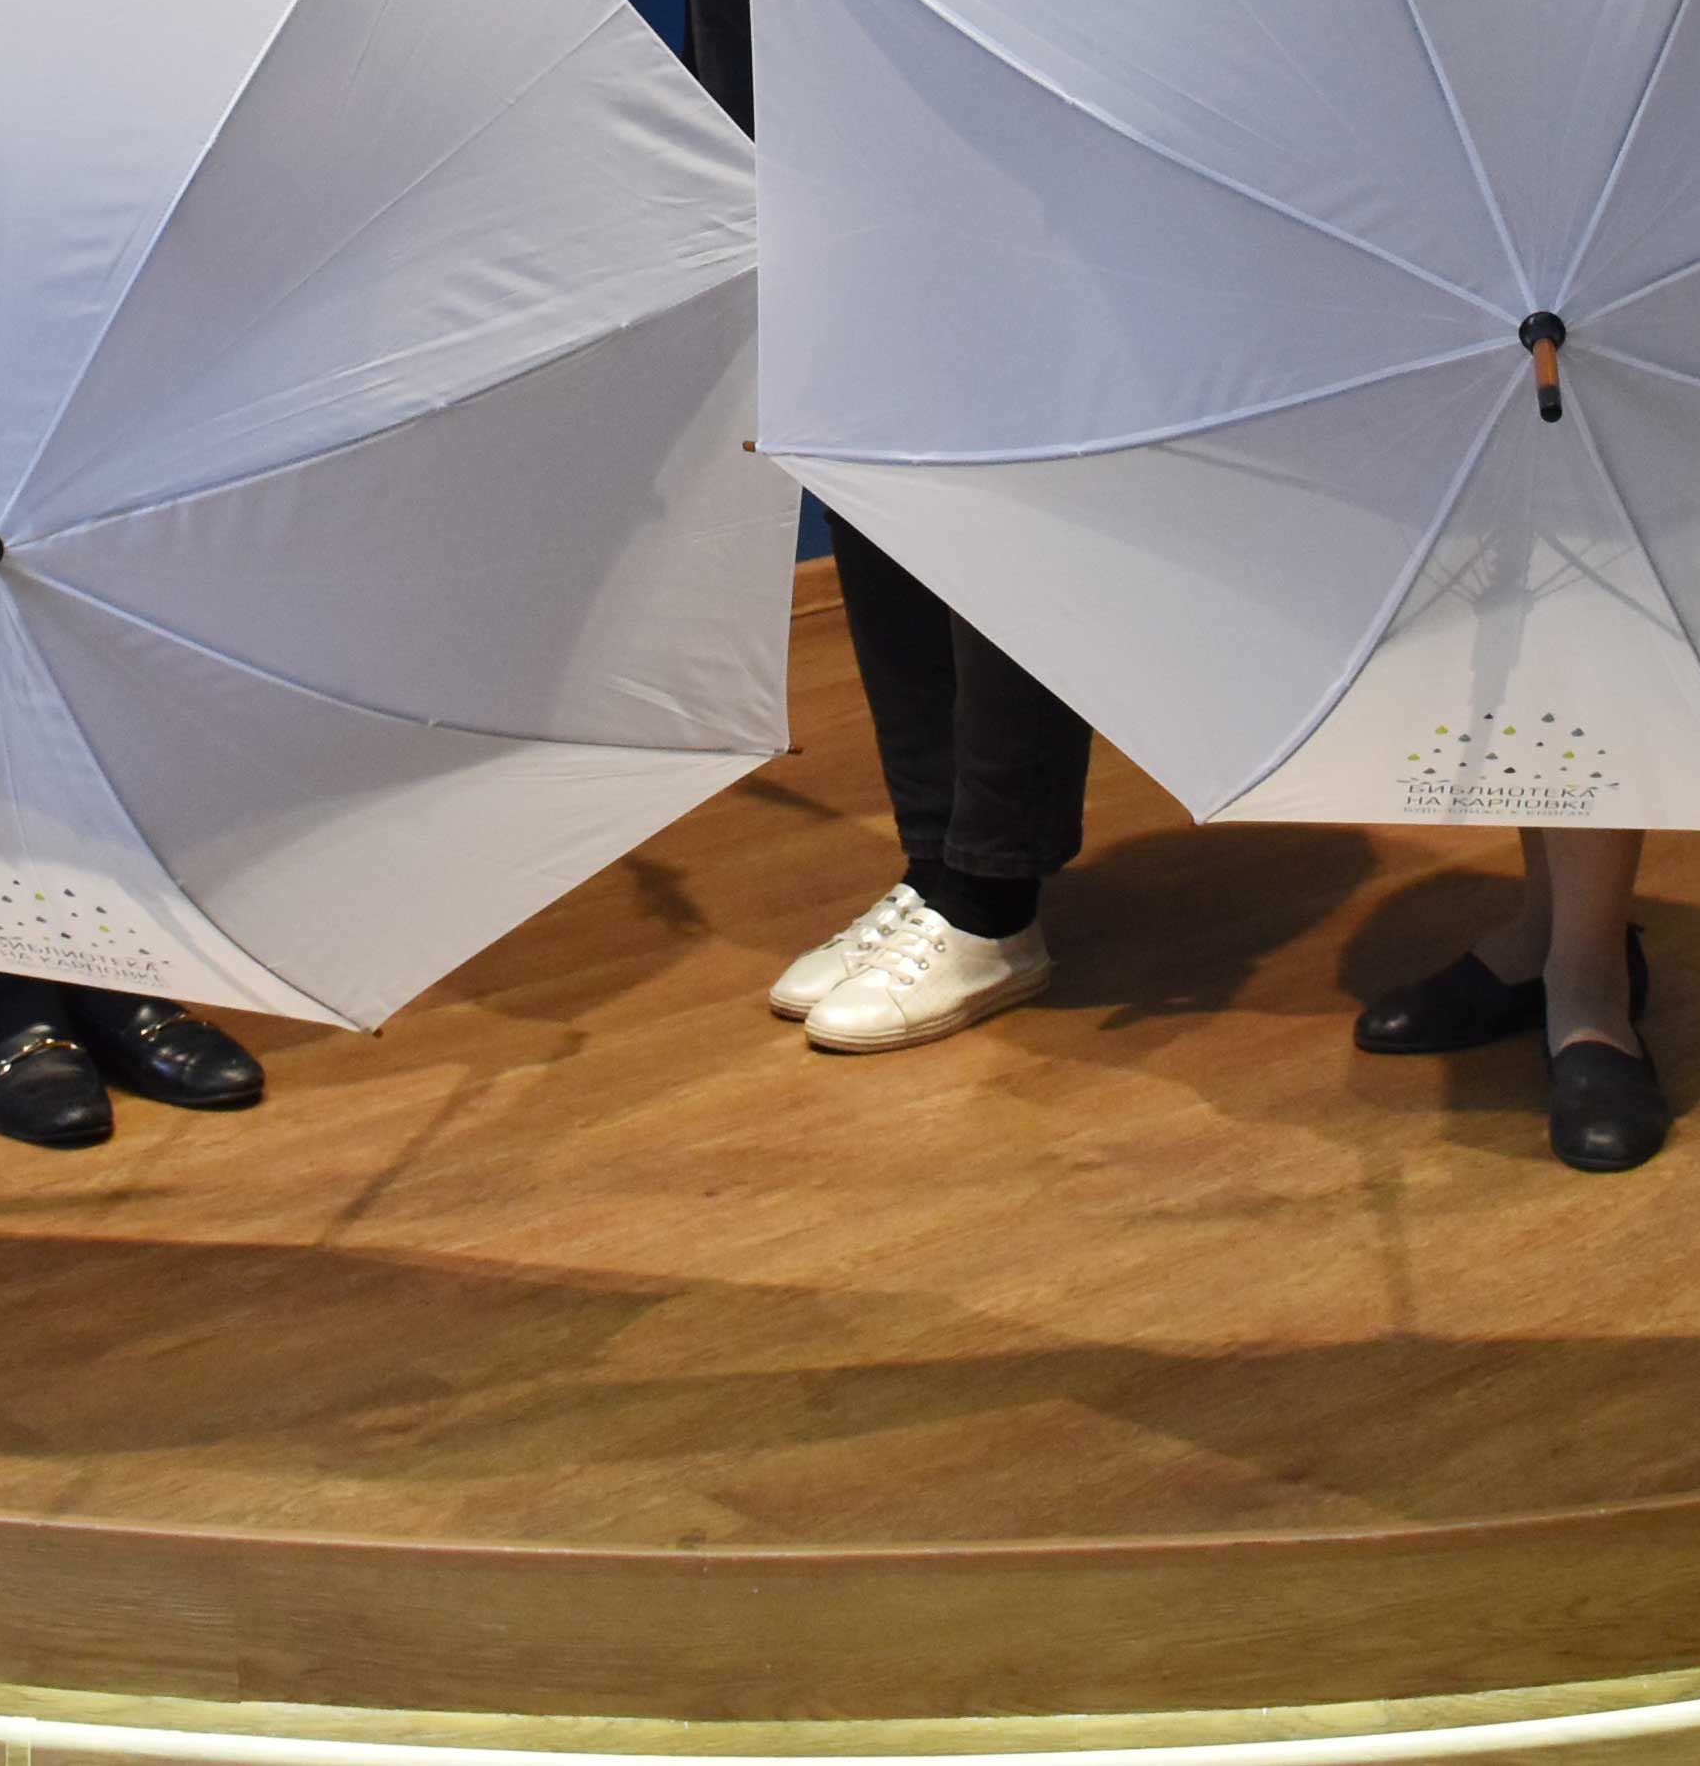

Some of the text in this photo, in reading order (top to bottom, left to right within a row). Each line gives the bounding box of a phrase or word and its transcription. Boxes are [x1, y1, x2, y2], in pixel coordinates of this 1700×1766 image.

[1409, 784, 1595, 798] БИБЛИОТЕКА
[1407, 796, 1588, 810] НА КАРПОВКЕ
